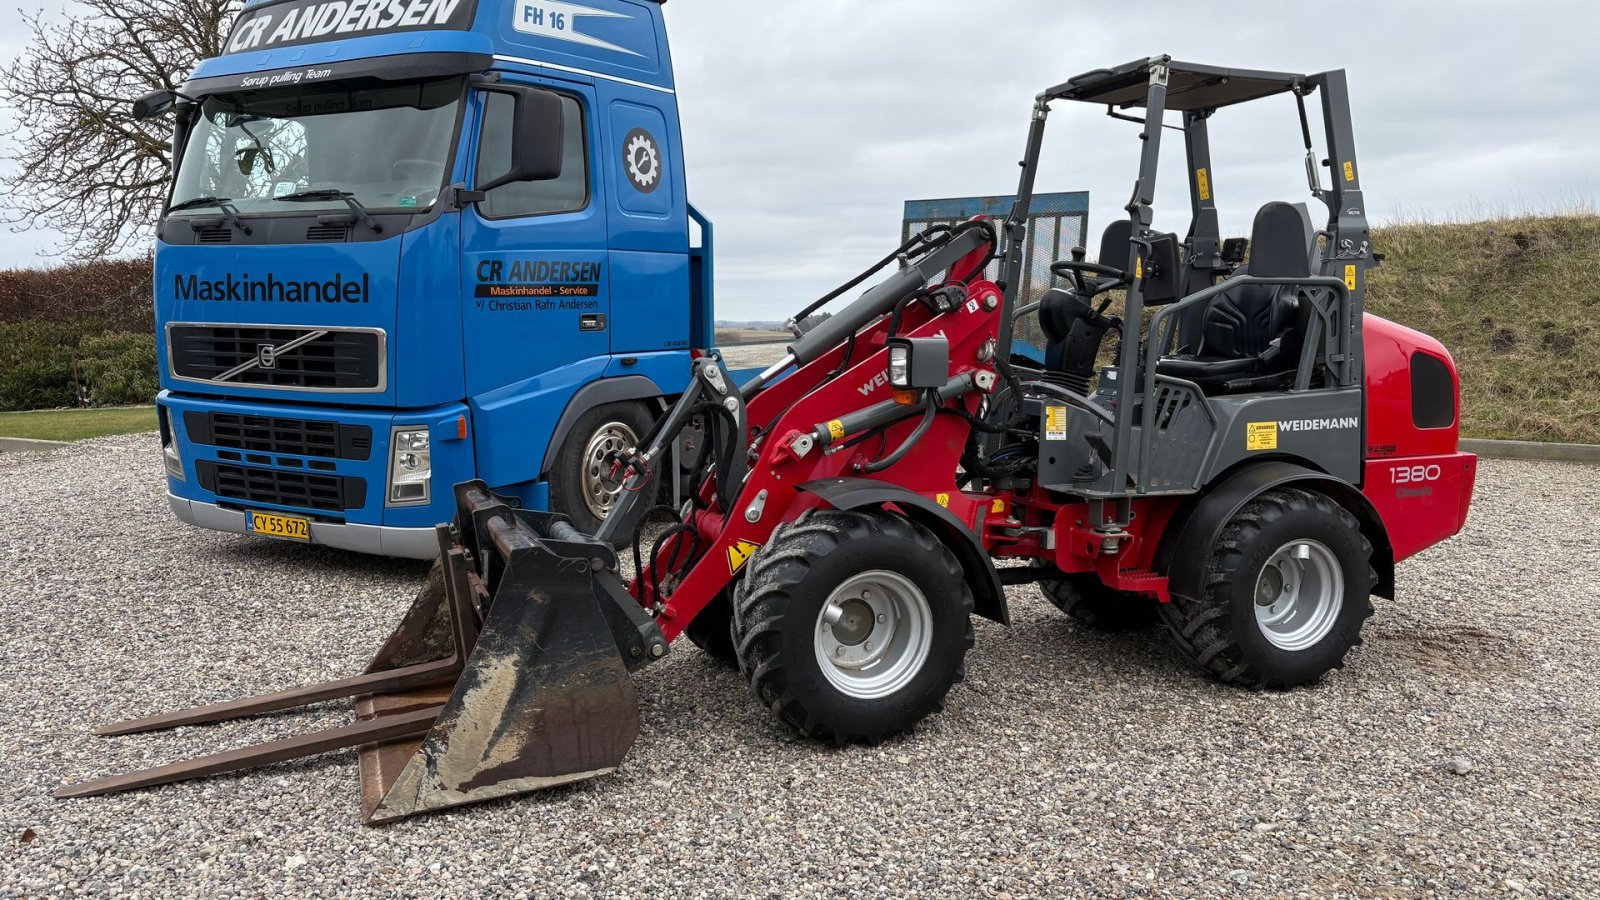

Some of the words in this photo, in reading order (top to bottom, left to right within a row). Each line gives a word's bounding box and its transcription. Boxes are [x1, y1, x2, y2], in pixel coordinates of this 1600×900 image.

[229, 14, 272, 53] CR
[265, 0, 459, 45] ANDERSEN
[523, 5, 544, 26] FH
[549, 11, 565, 31] 16
[268, 71, 303, 84] pulling
[305, 69, 332, 79] Team
[476, 259, 503, 282] CR
[507, 260, 602, 282] ANDERSEN
[174, 272, 369, 303] Maskinhandel
[490, 286, 552, 296] Maskinhandel
[559, 286, 588, 295] Service
[488, 300, 532, 312] Christian
[535, 300, 556, 310] Rafn
[559, 299, 598, 309] Andersen
[1278, 416, 1358, 432] WEIDEMANN
[1389, 464, 1441, 484] 1380
[254, 515, 267, 530] CY
[269, 517, 283, 532] 55
[286, 519, 308, 535] 672
